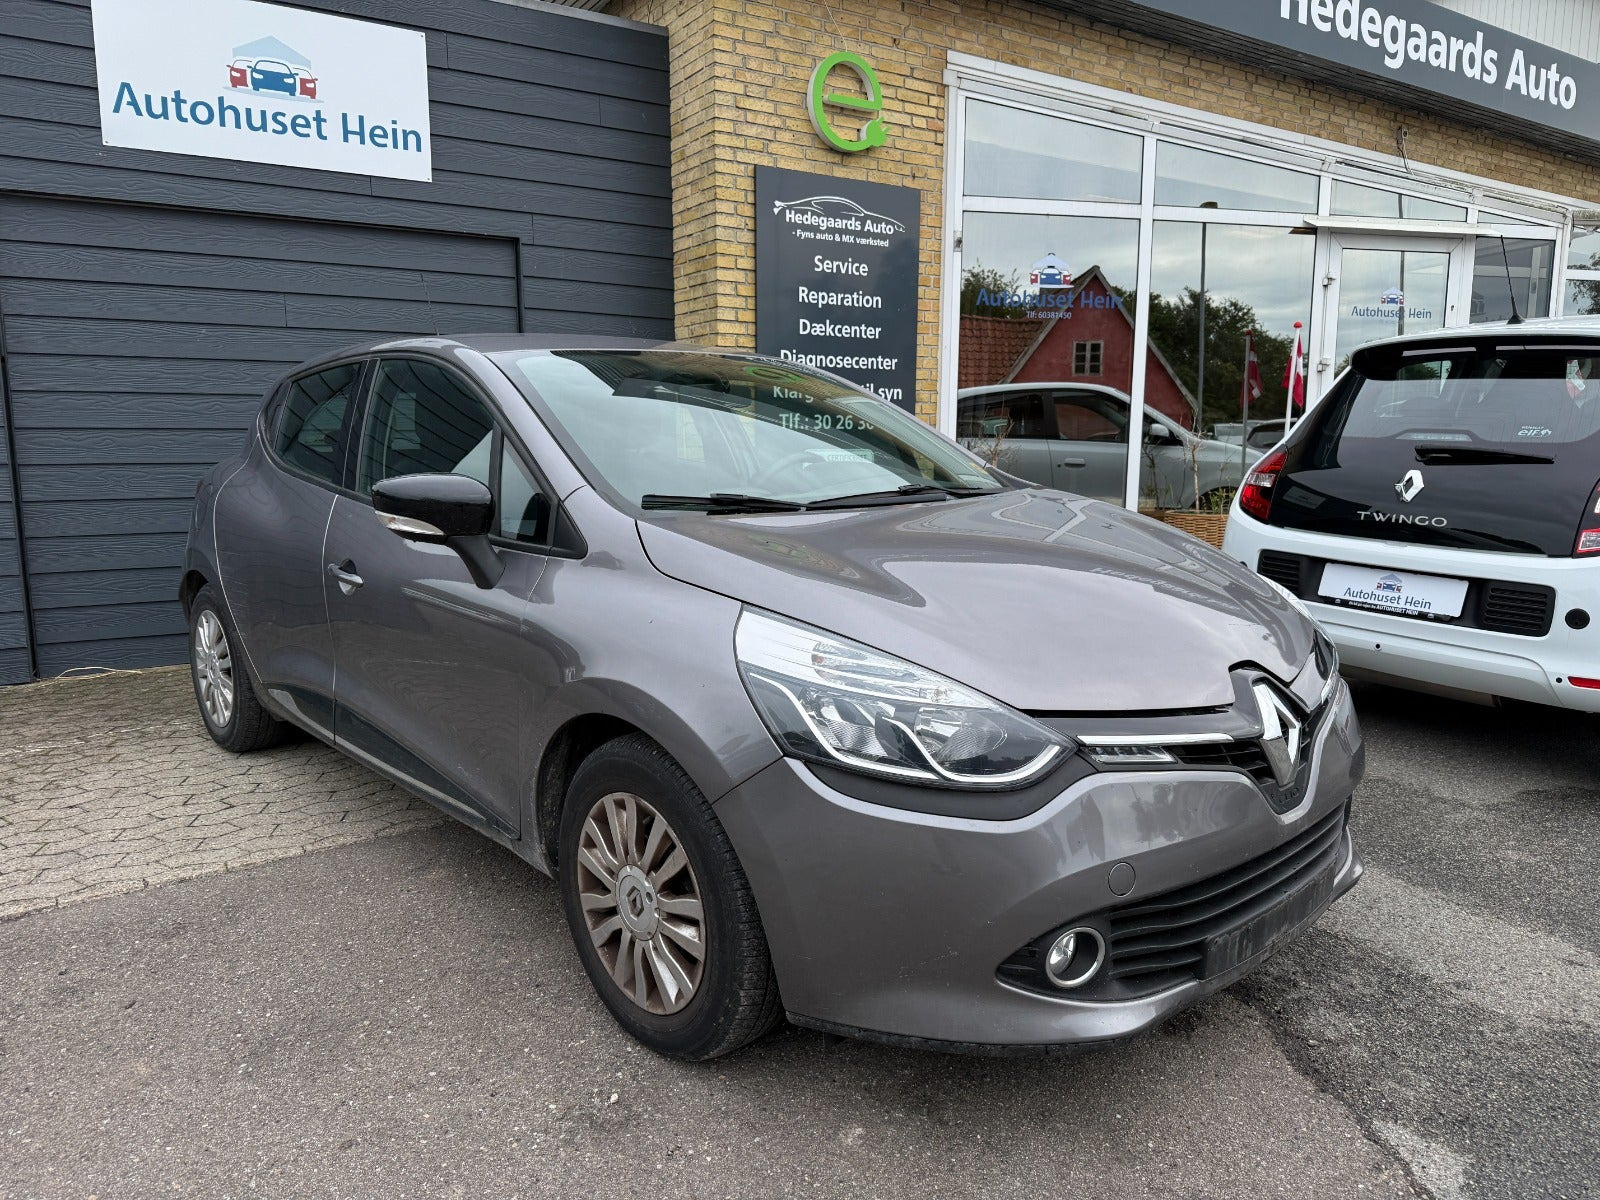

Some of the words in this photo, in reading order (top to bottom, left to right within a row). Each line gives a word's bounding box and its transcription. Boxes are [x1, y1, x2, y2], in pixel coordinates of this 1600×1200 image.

[1504, 48, 1577, 110] Auto
[112, 81, 327, 141] Autohuset
[341, 112, 422, 152] Hein
[785, 209, 862, 231] Hedegaards
[863, 219, 894, 235] Auto
[796, 229, 815, 240] Fyns
[815, 232, 834, 241] auto
[834, 233, 841, 242] &
[841, 234, 855, 244] MX
[855, 237, 889, 247] værksted
[814, 255, 869, 276] Service
[798, 286, 882, 309] Reparation
[976, 287, 1074, 308] Autohuset
[1081, 290, 1123, 309] Hein
[1408, 307, 1432, 319] Hein
[799, 318, 882, 339] Dækcenter
[780, 349, 898, 370] Diagnosecenter
[878, 387, 903, 402] syn
[814, 414, 832, 430] 30
[836, 414, 854, 430] 26
[1356, 510, 1448, 527] TWINGO
[1343, 587, 1402, 605] Autohuset
[1404, 595, 1432, 610] Hein
